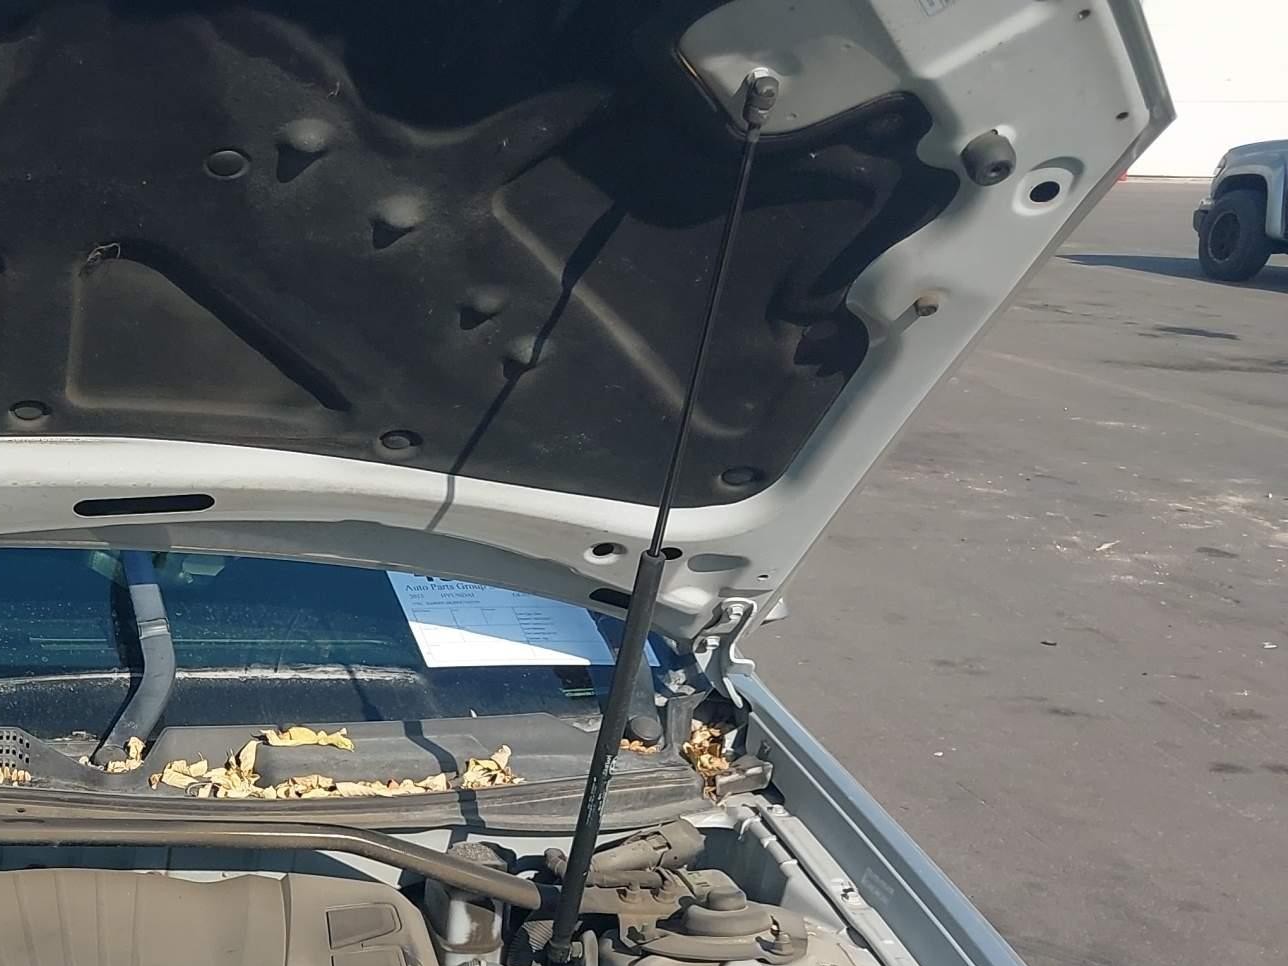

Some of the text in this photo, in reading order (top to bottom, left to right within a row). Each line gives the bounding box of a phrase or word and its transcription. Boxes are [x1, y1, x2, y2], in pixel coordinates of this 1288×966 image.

[404, 582, 487, 592] Auto Parts Group
